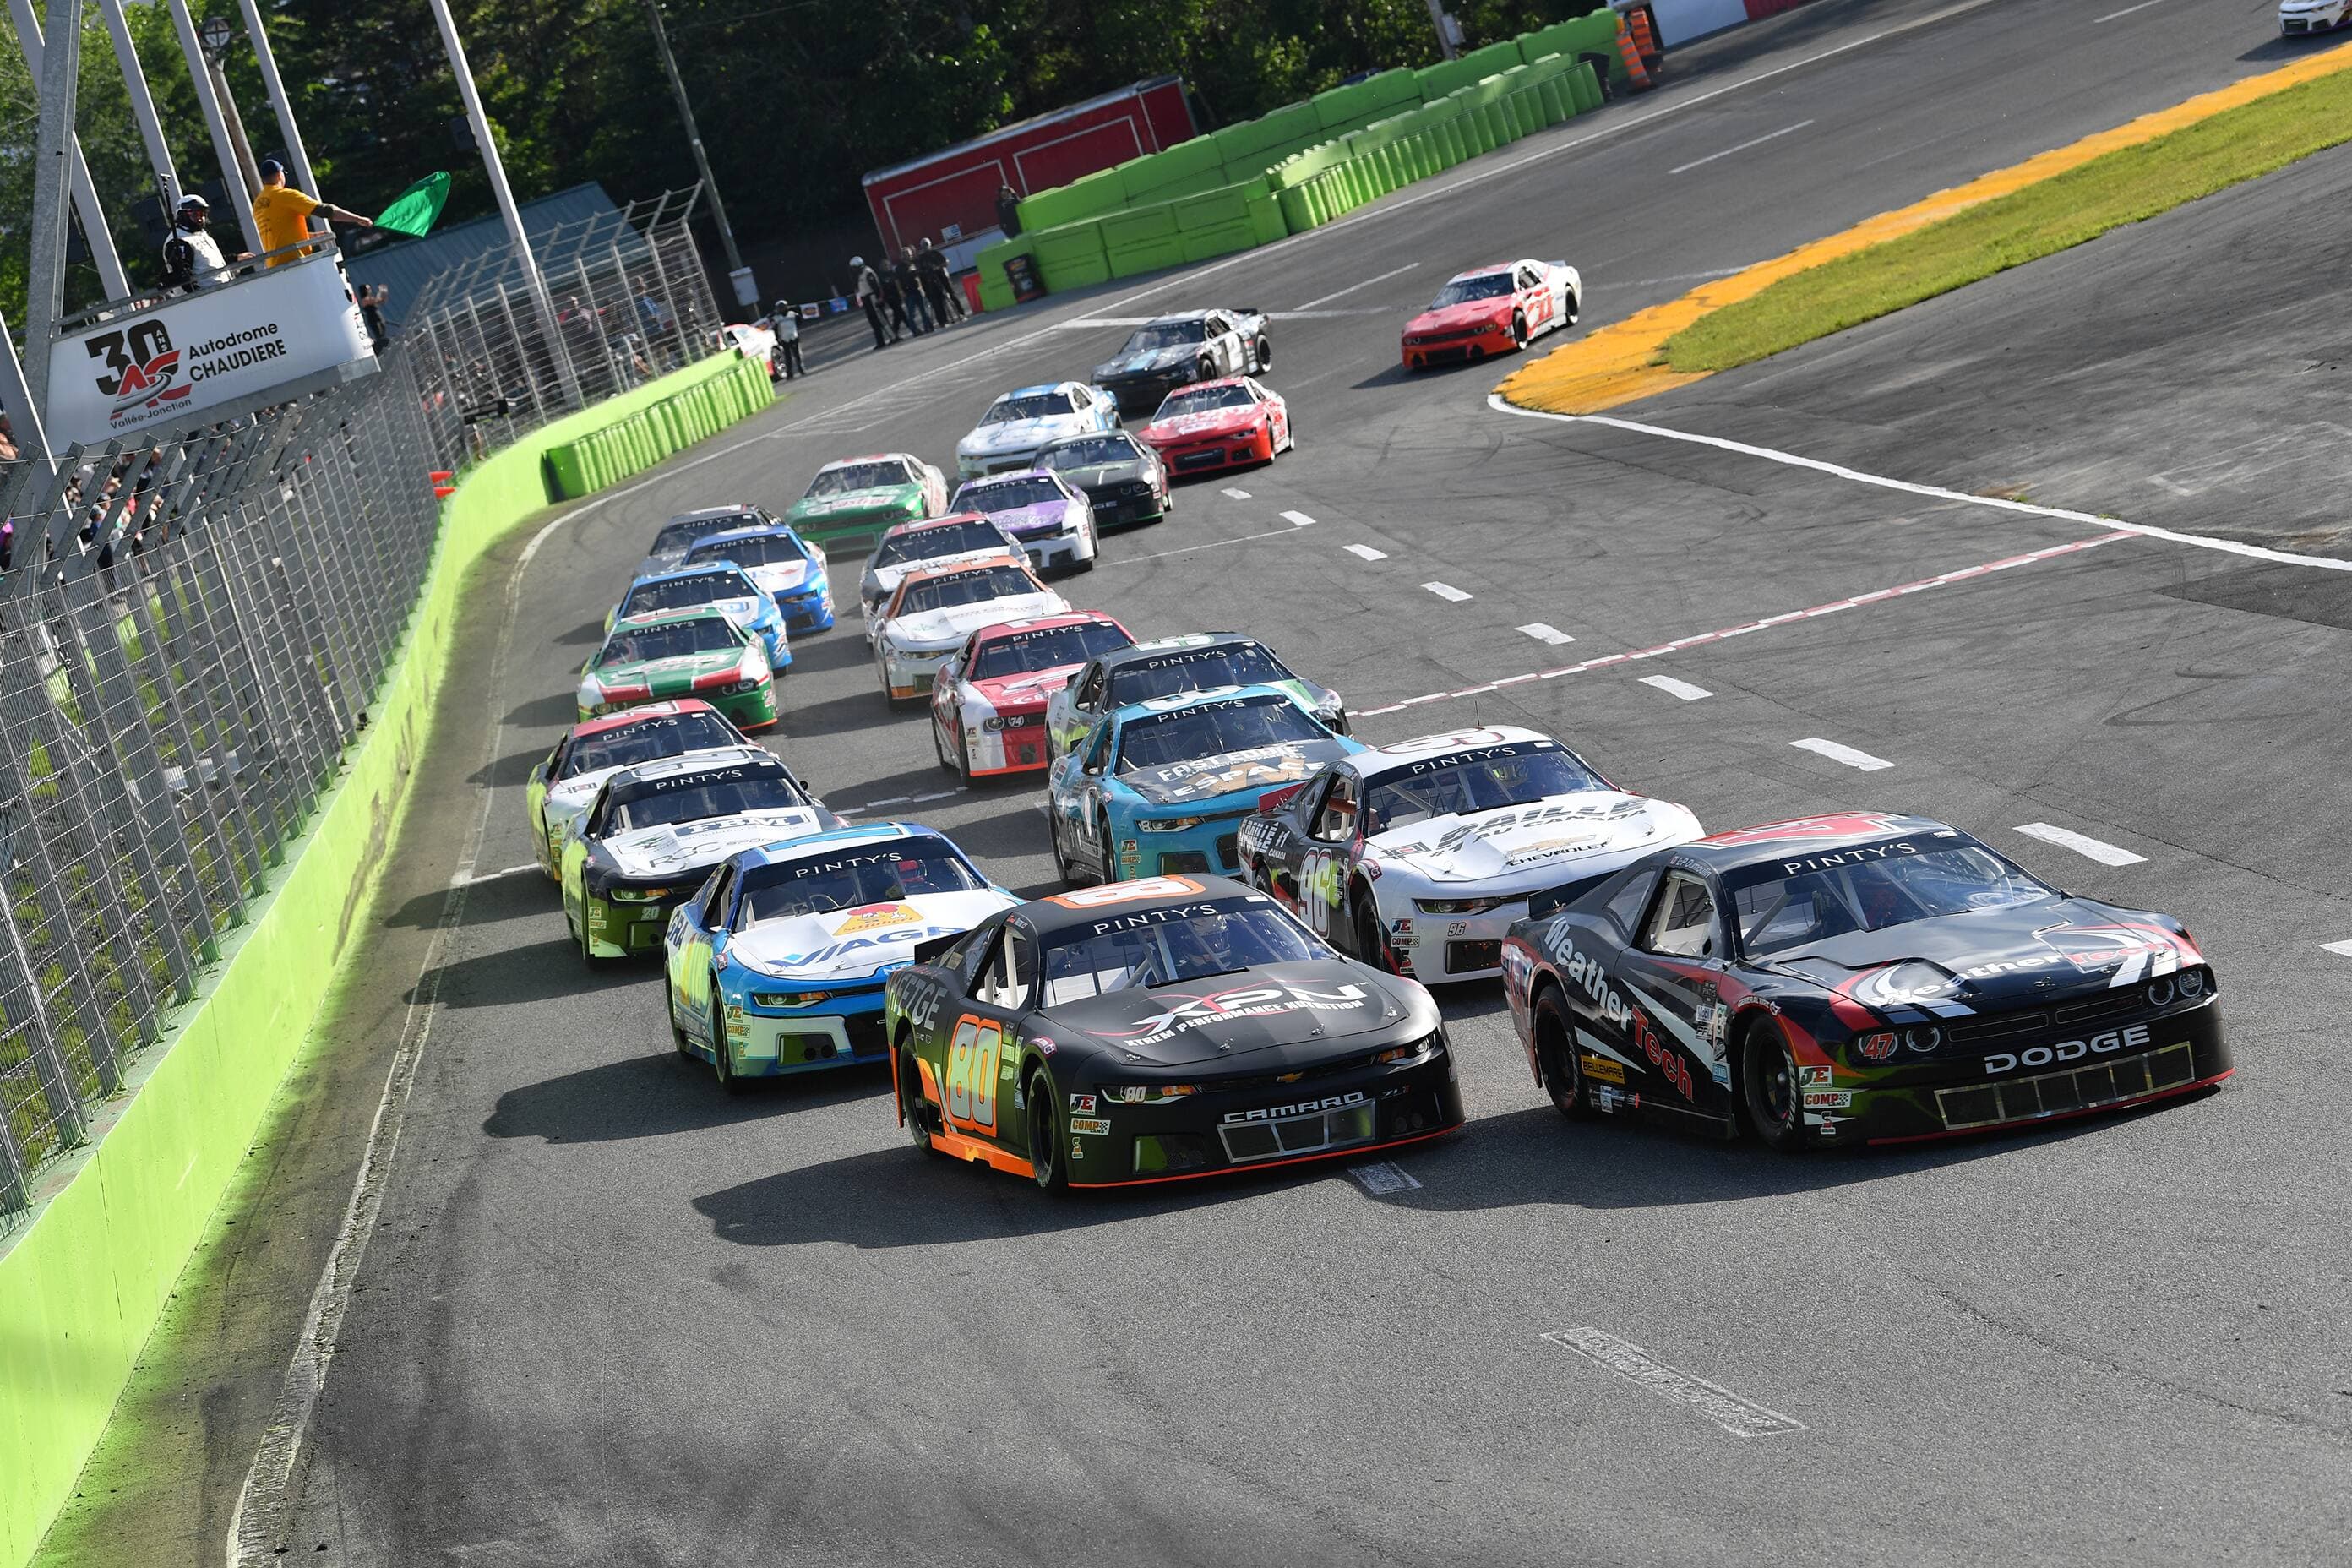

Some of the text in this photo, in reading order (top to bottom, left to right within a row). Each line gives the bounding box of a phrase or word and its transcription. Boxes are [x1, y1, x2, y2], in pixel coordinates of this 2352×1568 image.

[155, 329, 167, 351] ANS
[188, 323, 278, 360] Autodrome
[189, 339, 286, 382] CHAUDIERE
[110, 398, 192, 430] Vallée-Jonction
[714, 537, 765, 549] PINTY'S
[907, 525, 962, 539] PINTY'S
[659, 576, 716, 590] PINTY'S
[933, 569, 994, 585] PINTY'S
[634, 621, 695, 636] PINTY'S
[1013, 626, 1083, 642] PINTY'S
[1149, 651, 1227, 670] PINTY'S
[1158, 700, 1245, 723] PINTY'S
[603, 718, 678, 741] PINTY'S
[1157, 757, 1219, 781] FAST
[1411, 747, 1516, 774] PINTY'S
[656, 770, 742, 790] PINTY'S
[1173, 761, 1326, 797] ESPACE
[1473, 826, 1512, 844] AU
[1524, 810, 1646, 827] CANADA
[796, 852, 902, 878] PINTY'S
[1507, 841, 1608, 866] CHEVROLET
[1784, 842, 1918, 874] PINTY'S
[1299, 847, 1333, 940] 96
[641, 906, 661, 921] 20
[1093, 903, 1217, 934] PINTY'S
[1448, 922, 1466, 936] 96
[1544, 917, 1694, 1102] WeatherTech
[1124, 1000, 1365, 1047] XTREM PERFORMANCE NUTRITION
[1864, 1033, 1894, 1059] 47
[1984, 1025, 2150, 1074] DODGE
[946, 1013, 1003, 1138] 80
[1583, 1061, 1624, 1079] BELLEMARE
[1800, 1067, 1829, 1085] JE
[1070, 1095, 1095, 1112] JE
[1124, 1086, 1147, 1102] 80
[1805, 1093, 1839, 1104] COMP
[1224, 1092, 1364, 1124] CAMARO
[1073, 1119, 1099, 1130] COMP
